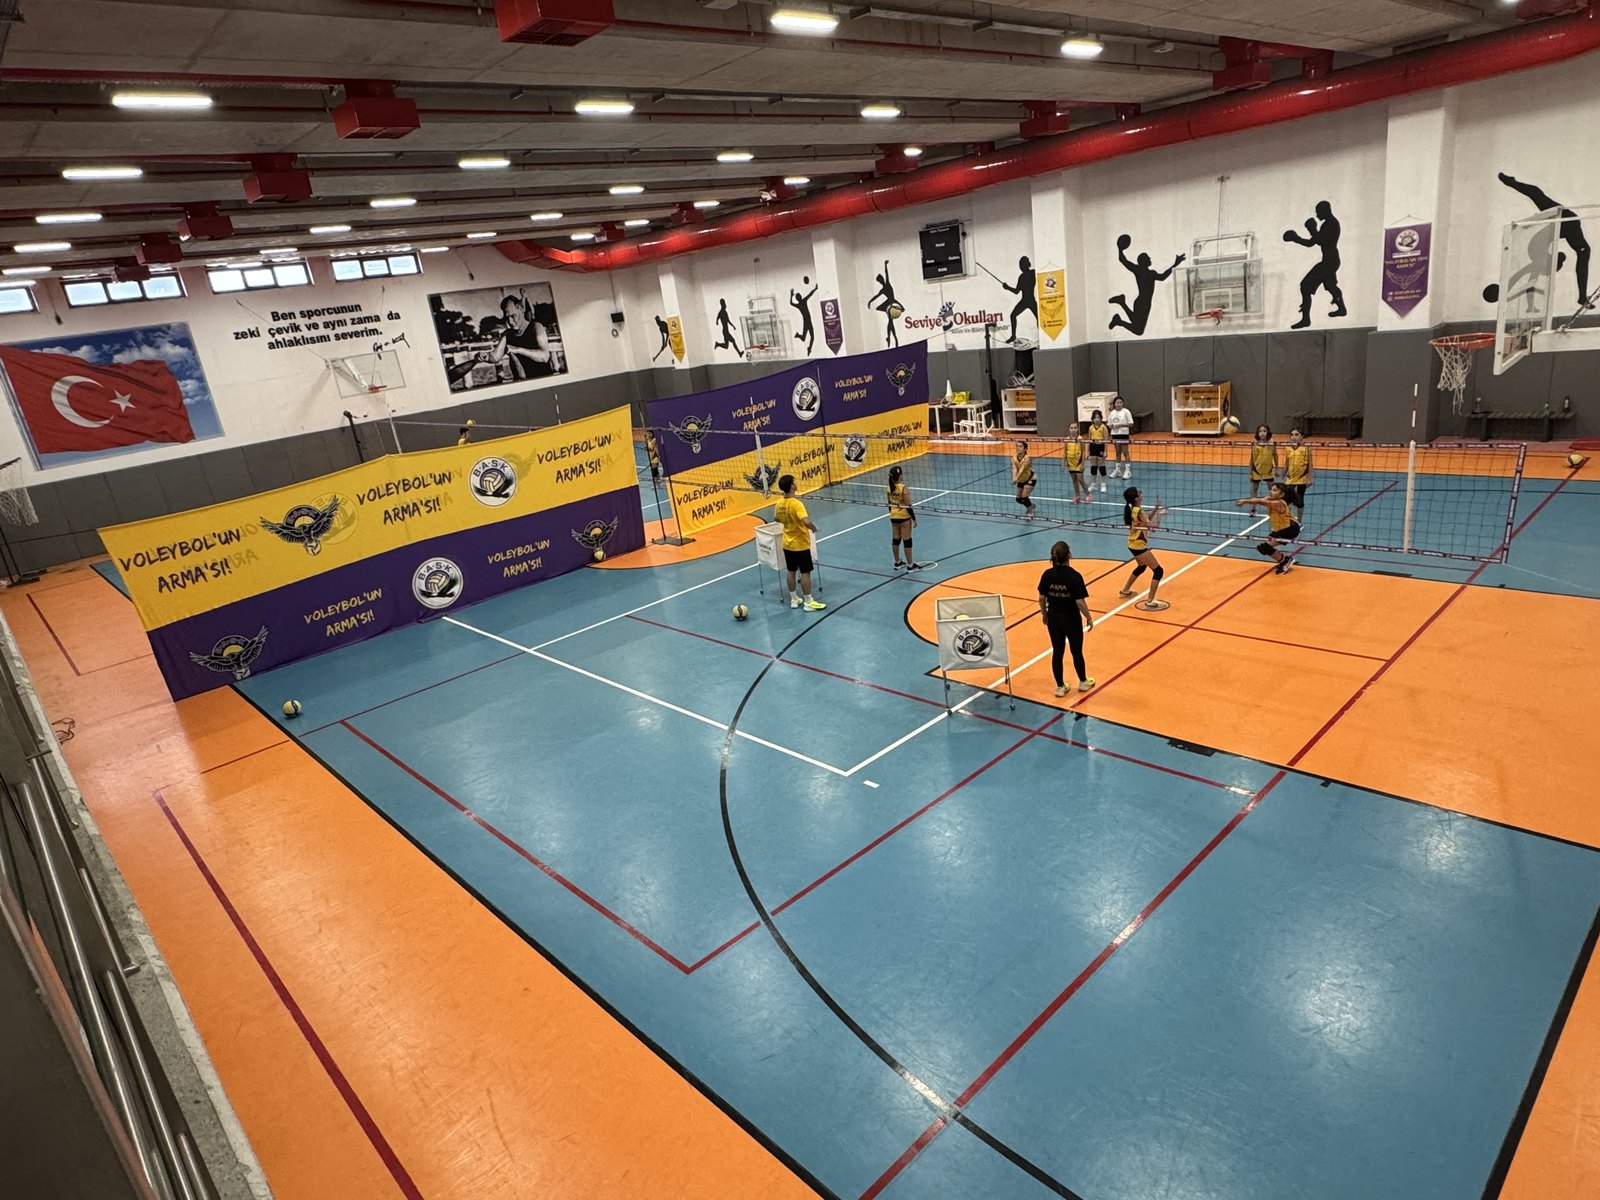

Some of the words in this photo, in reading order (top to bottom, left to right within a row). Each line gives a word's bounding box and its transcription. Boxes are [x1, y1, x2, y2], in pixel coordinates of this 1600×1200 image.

[233, 327, 261, 340] zeki
[268, 323, 302, 338] çevik
[305, 322, 320, 332] ve
[323, 318, 347, 332] aynı
[350, 315, 381, 326] zama
[387, 310, 401, 321] da
[271, 310, 296, 322] Ben
[300, 304, 362, 320] sporcunun
[904, 315, 942, 330] Seviye
[953, 310, 1004, 326] Okulları
[268, 333, 331, 350] ahlaklısını
[334, 327, 383, 342] severim.
[732, 399, 776, 418] VOLEYBOL'UN
[537, 434, 612, 465] VOLEYBOL'UN
[790, 443, 835, 467] VOLEYBOLUN
[555, 458, 602, 484] ARMA'SI!
[356, 471, 452, 506] VOLEYBOL'UN
[383, 496, 442, 525] ARMA'SI!
[692, 498, 726, 521] ARMA'SI!
[119, 528, 241, 572] VOLEYBOL'UN
[487, 538, 551, 564] VOLEYBOL'UN
[158, 558, 233, 593] ARMA'SI!
[503, 559, 543, 578] ARMA'SI!
[303, 588, 382, 625] VOLEYBOL'UN
[326, 609, 375, 637] ARMA'SI!
